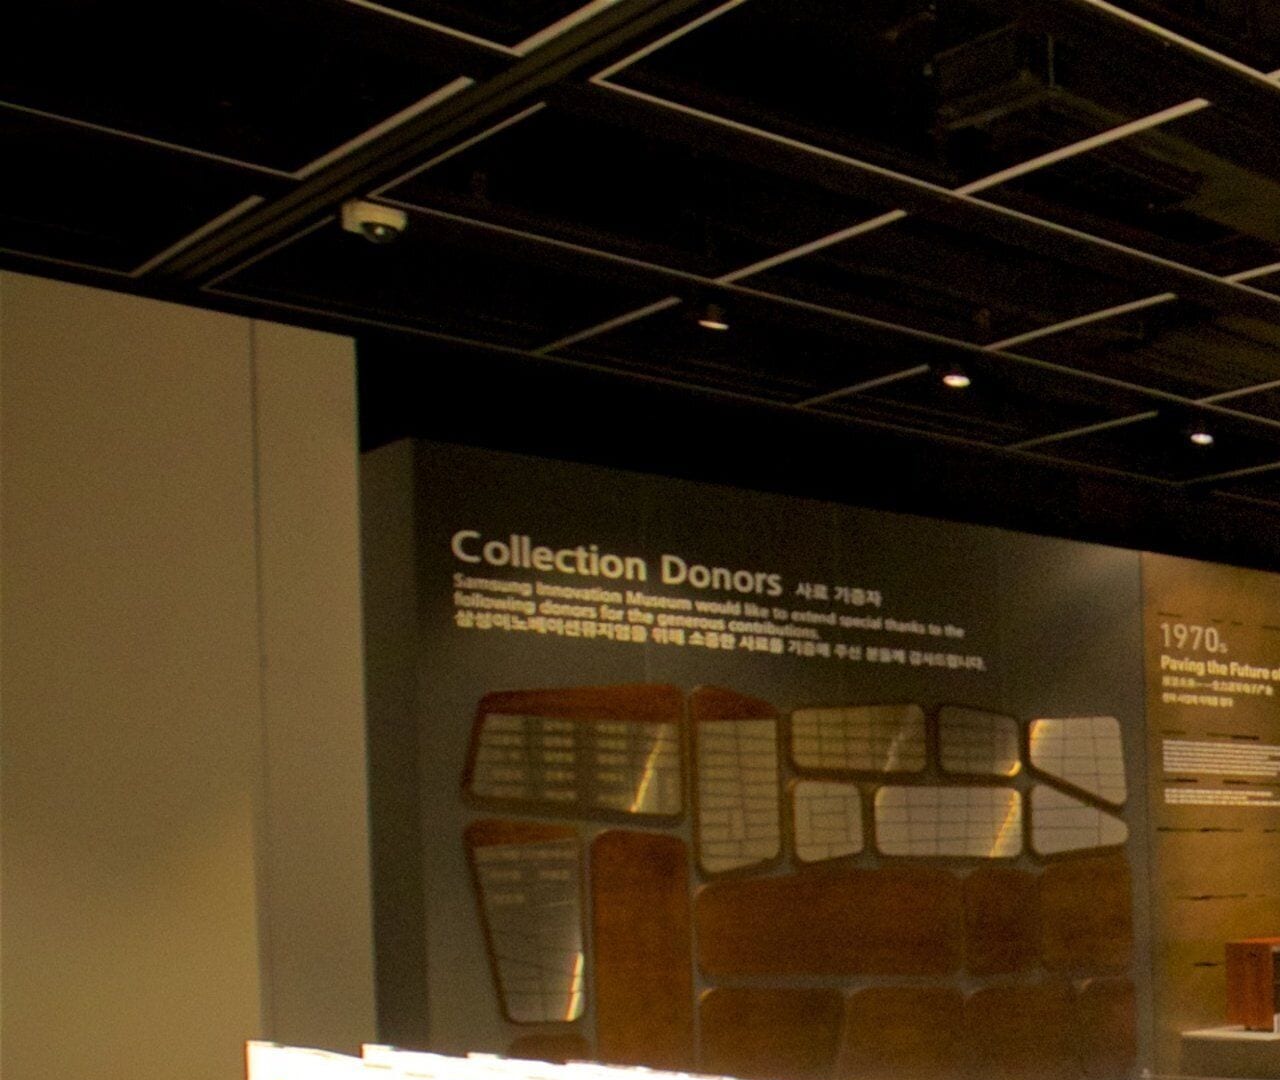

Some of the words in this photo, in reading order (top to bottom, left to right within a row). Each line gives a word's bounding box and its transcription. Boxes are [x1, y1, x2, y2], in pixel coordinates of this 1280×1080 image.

[451, 530, 647, 582] Collection
[661, 553, 783, 597] Donors
[453, 573, 533, 596] Samsung
[535, 581, 622, 604] Innovation
[626, 591, 692, 610] Museum
[695, 599, 742, 616] would
[744, 602, 769, 618] like
[773, 606, 788, 621] to
[791, 610, 837, 626] extend
[839, 614, 883, 631] special
[885, 618, 926, 635] thanks
[928, 622, 942, 636] to
[944, 623, 966, 639] the
[454, 591, 536, 615] following
[539, 600, 597, 619] donors
[600, 603, 624, 621] for
[627, 608, 654, 625] the
[657, 613, 725, 631] generous
[1160, 622, 1228, 654] 1970s
[1160, 655, 1206, 677] Paving
[1207, 659, 1228, 676] the
[1230, 662, 1270, 680] Future
